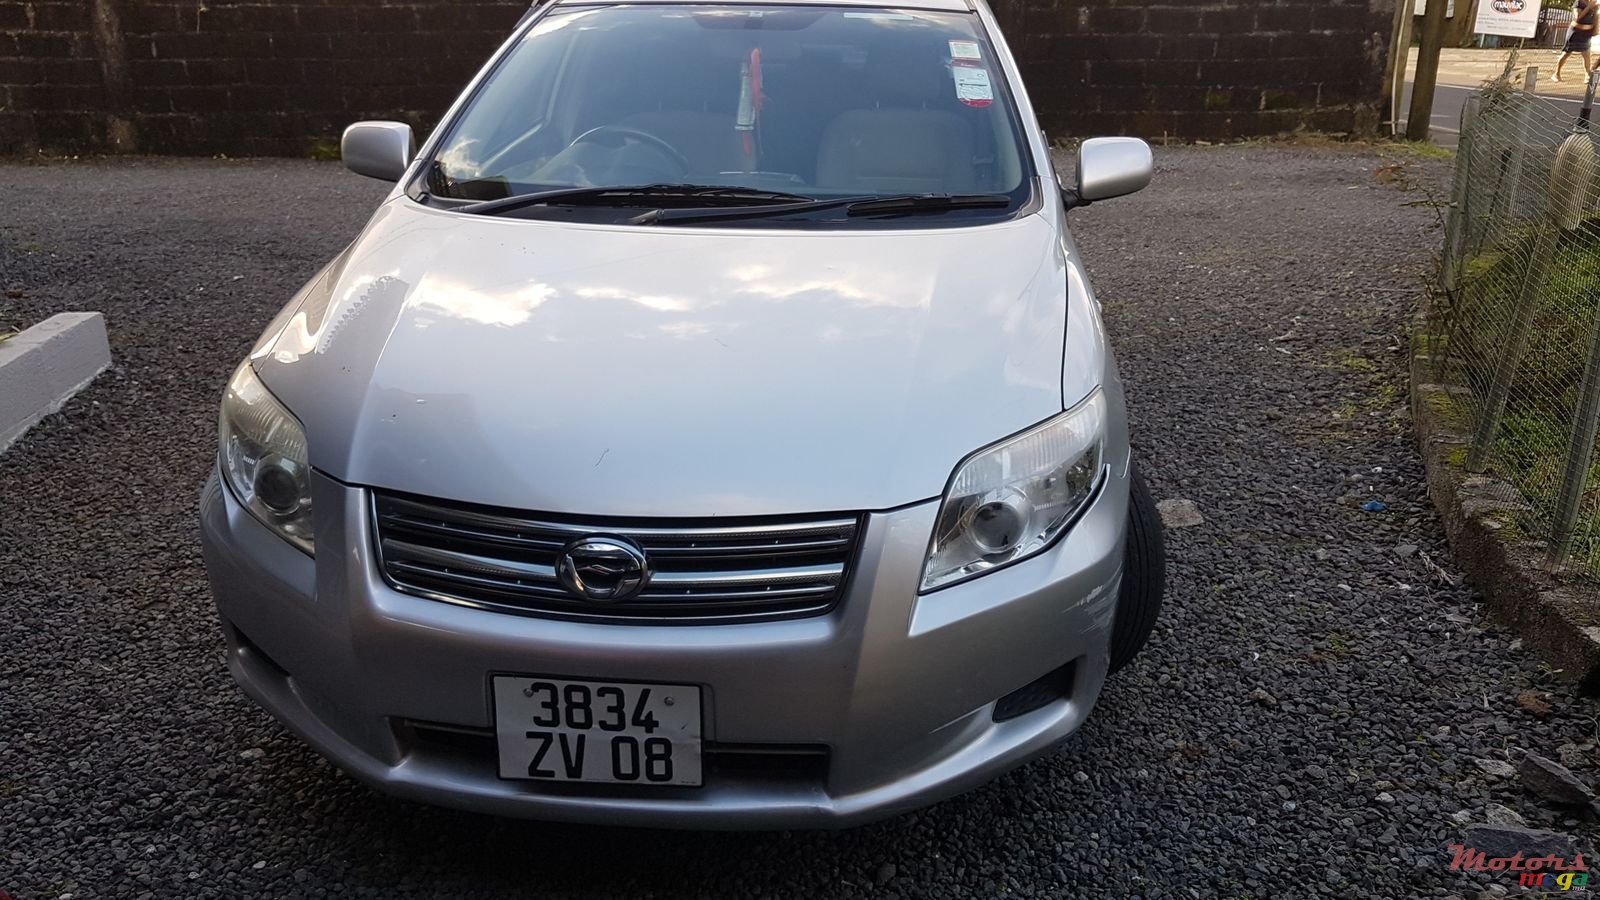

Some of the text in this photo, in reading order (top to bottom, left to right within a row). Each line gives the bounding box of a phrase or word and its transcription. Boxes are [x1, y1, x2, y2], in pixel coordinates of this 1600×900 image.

[531, 682, 659, 734] 3834
[526, 731, 673, 782] ZV 08
